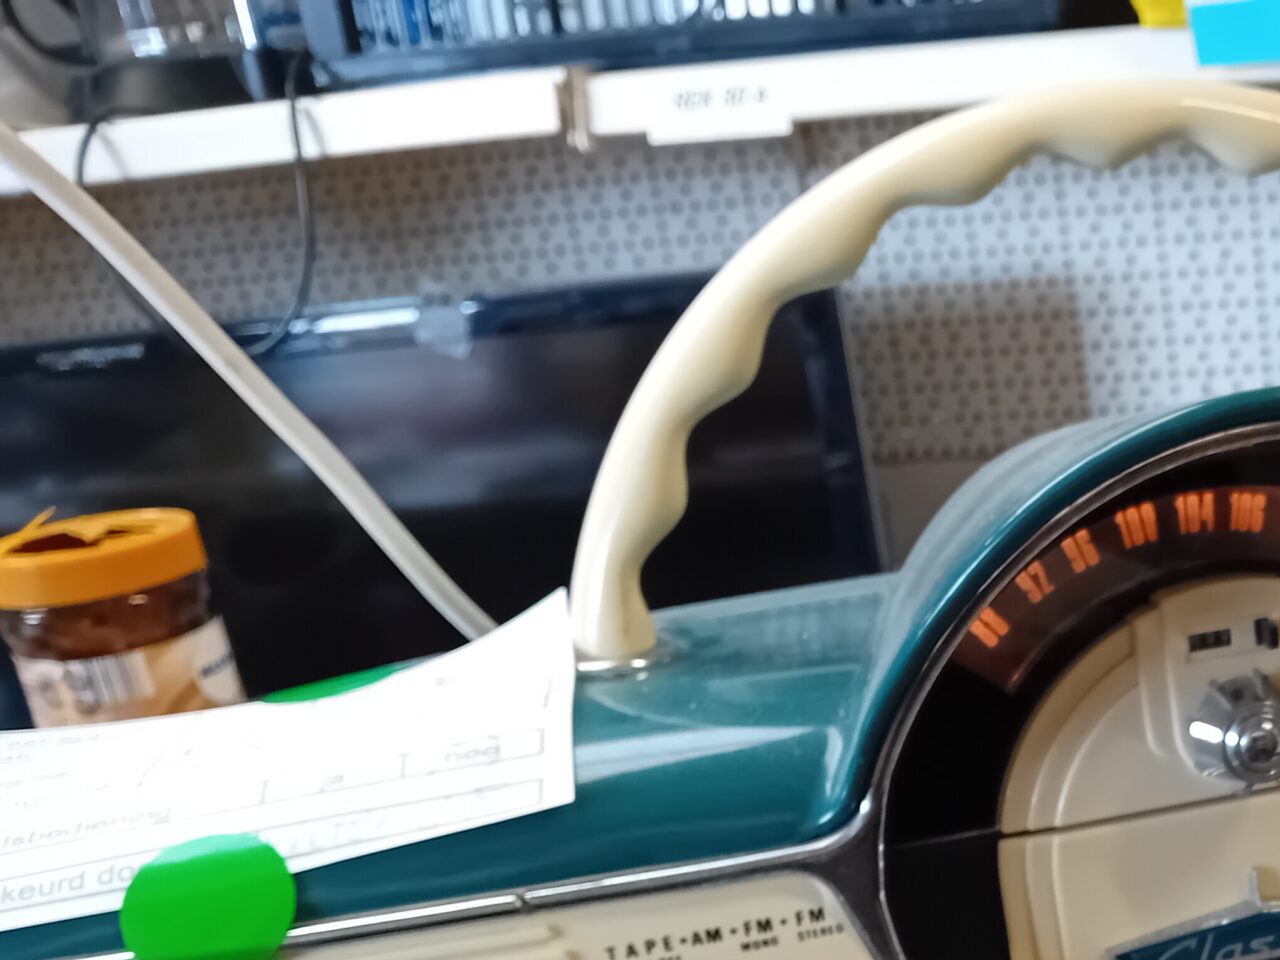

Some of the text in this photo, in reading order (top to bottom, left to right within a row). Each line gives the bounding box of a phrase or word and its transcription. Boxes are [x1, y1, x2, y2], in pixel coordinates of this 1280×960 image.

[0, 870, 87, 905] keurd
[691, 926, 724, 947] AM
[743, 916, 774, 937] FM
[795, 906, 826, 927] FM
[797, 923, 845, 943] STEREO
[740, 936, 779, 952] MONO
